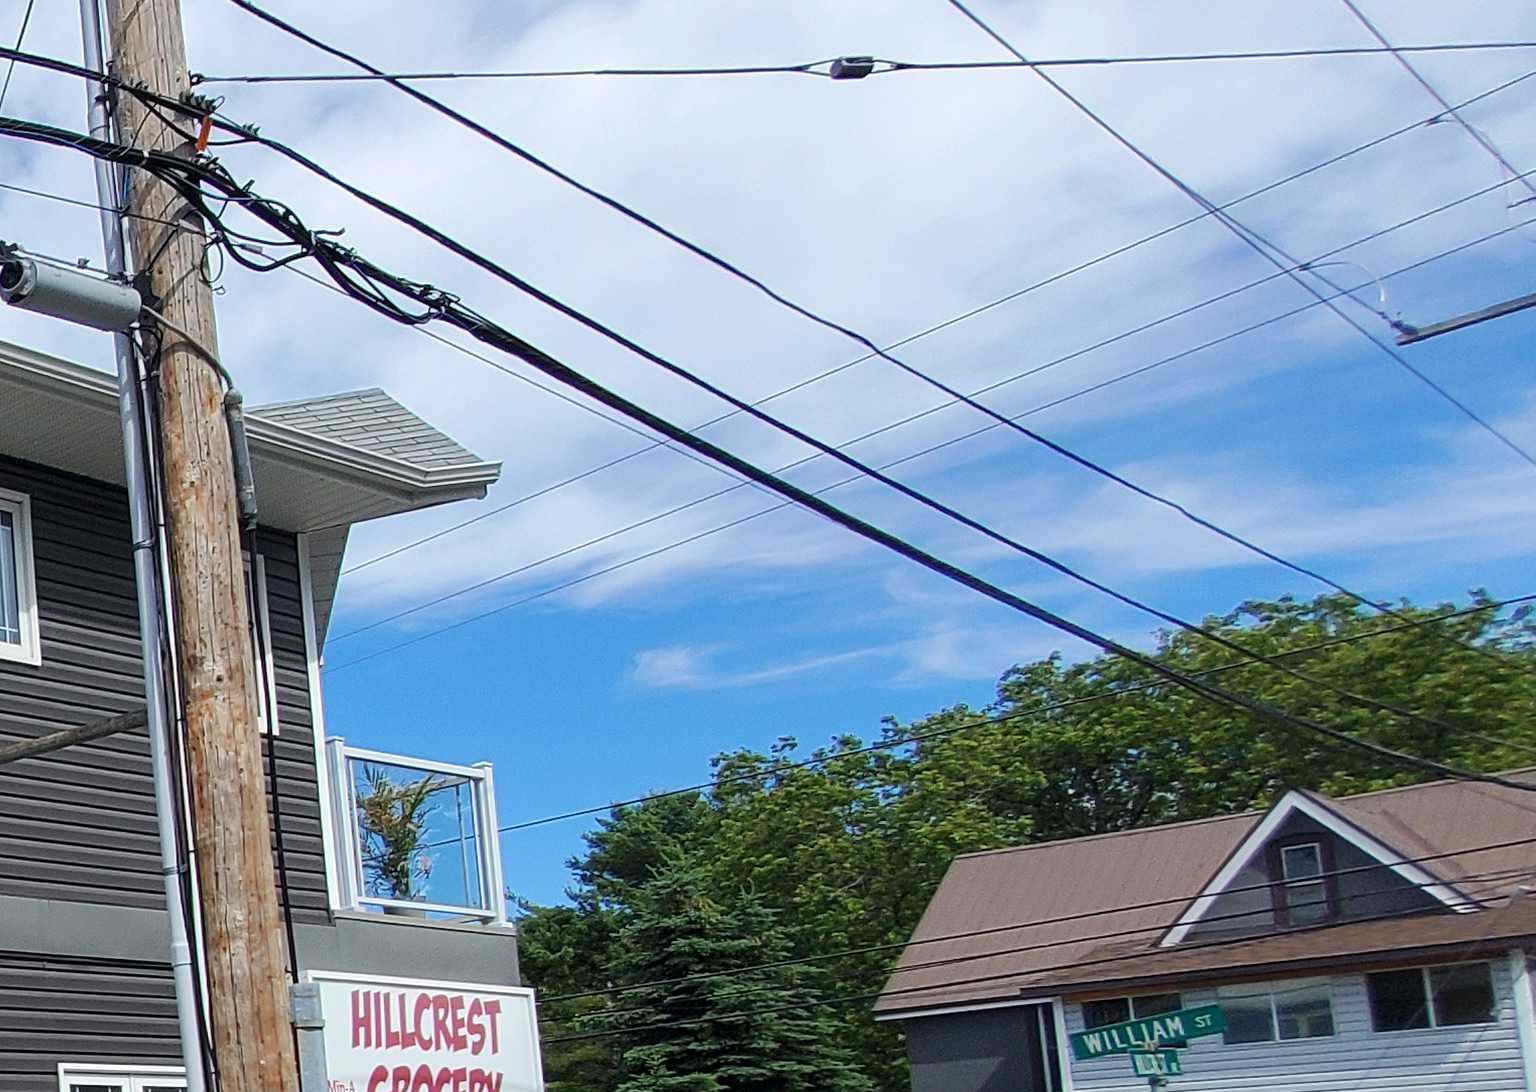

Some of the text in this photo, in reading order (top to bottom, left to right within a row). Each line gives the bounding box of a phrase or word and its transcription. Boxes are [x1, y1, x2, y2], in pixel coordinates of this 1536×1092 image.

[351, 990, 503, 1056] HILLCREST
[1083, 1014, 1212, 1054] WILLIAM ST
